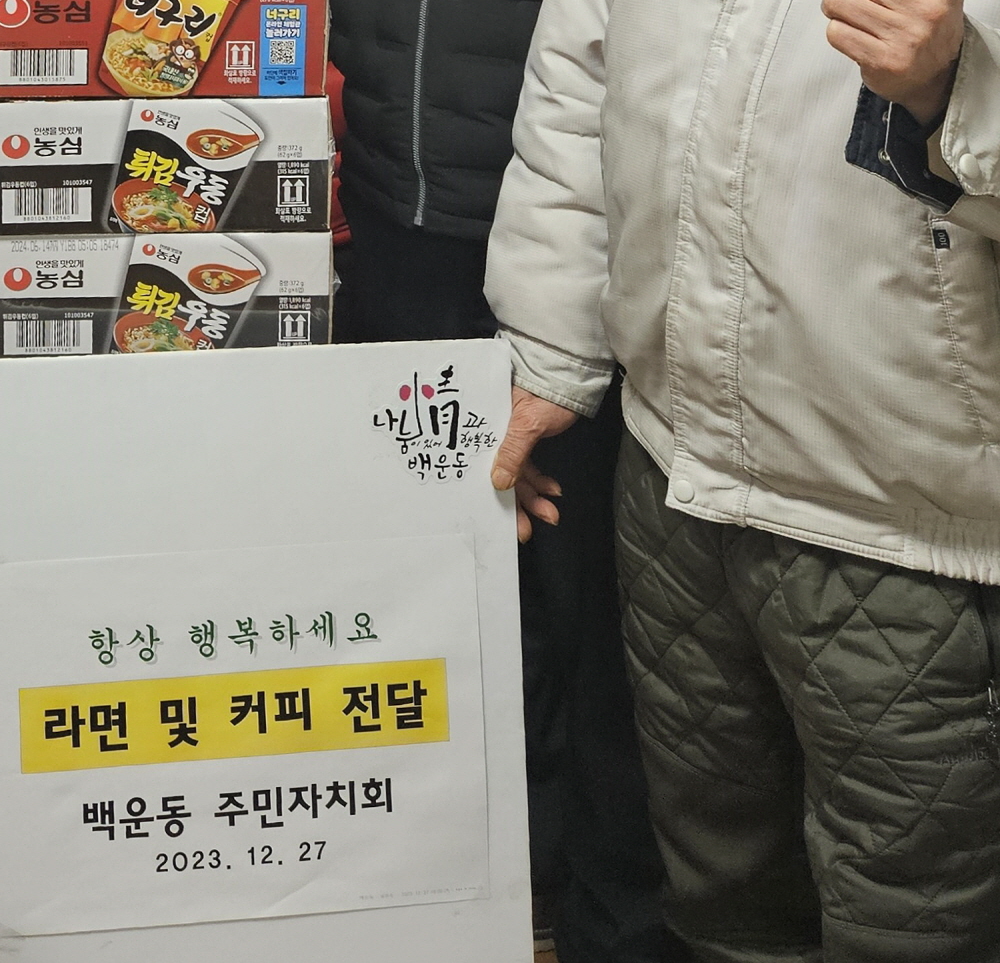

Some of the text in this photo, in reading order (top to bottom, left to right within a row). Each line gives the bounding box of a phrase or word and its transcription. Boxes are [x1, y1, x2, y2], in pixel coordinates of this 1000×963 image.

[32, 0, 92, 24] 농심
[265, 7, 301, 20] 너구리
[265, 28, 301, 38] 놀러가기
[34, 126, 83, 136] 인생을 맛있게
[155, 115, 180, 130] 농심
[33, 136, 83, 157] 농심
[194, 204, 212, 224] 컵
[35, 259, 85, 269] 인생을 맛있게
[156, 249, 181, 265] 농심
[35, 269, 84, 290] 농심
[408, 452, 469, 480] 백운동
[88, 611, 380, 665] 항상 행복하세요
[43, 679, 429, 753] 라면 및 커피 전달
[81, 777, 395, 842] 백운동 주민자치회
[155, 840, 328, 873] 2023. 12. 27
